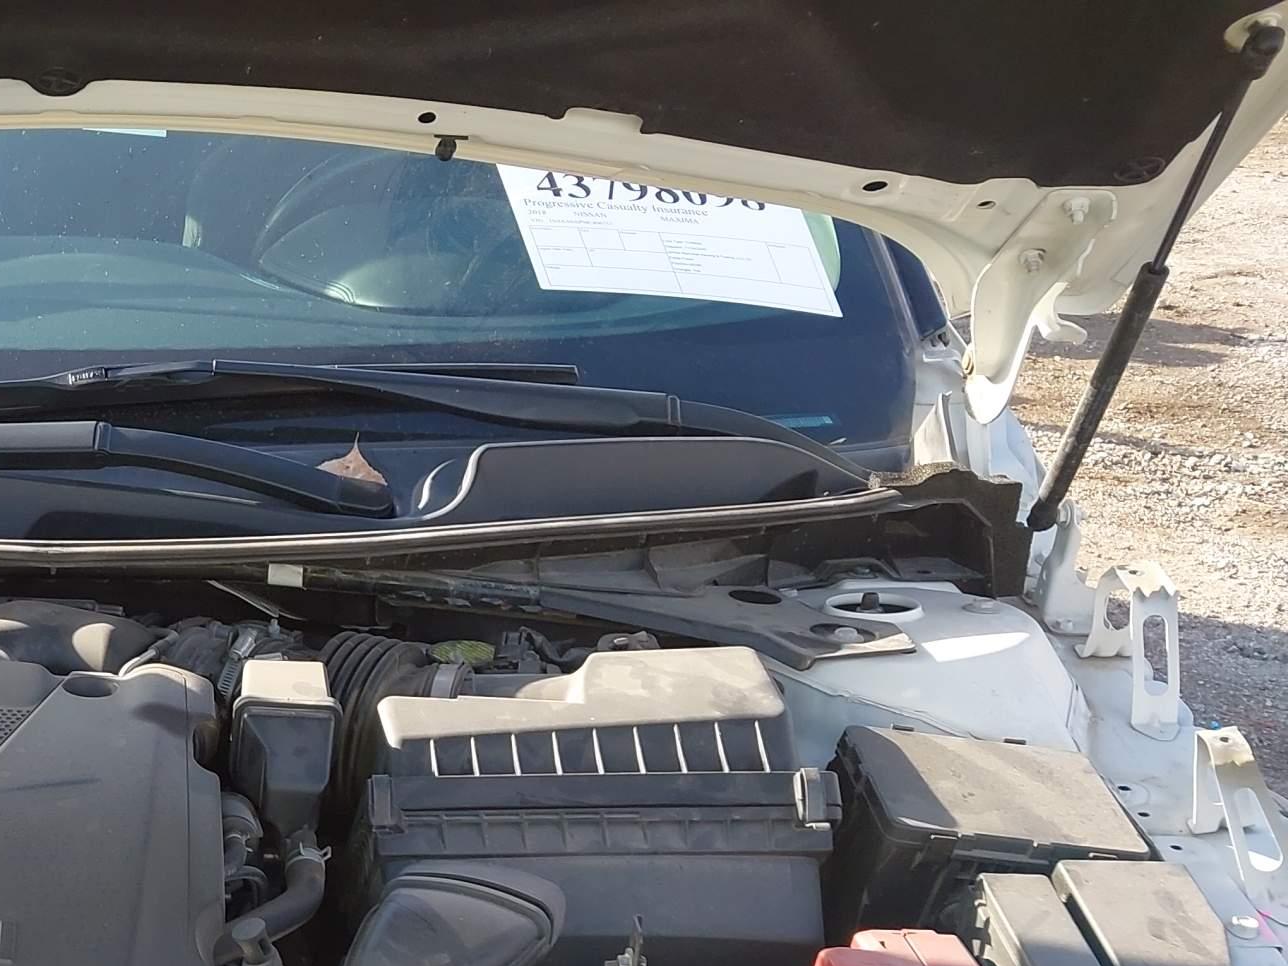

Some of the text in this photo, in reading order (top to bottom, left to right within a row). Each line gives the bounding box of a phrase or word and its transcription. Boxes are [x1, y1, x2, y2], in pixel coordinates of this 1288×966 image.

[523, 198, 709, 216] Progressive Casualty Insurance
[660, 216, 700, 225] MAXIMA
